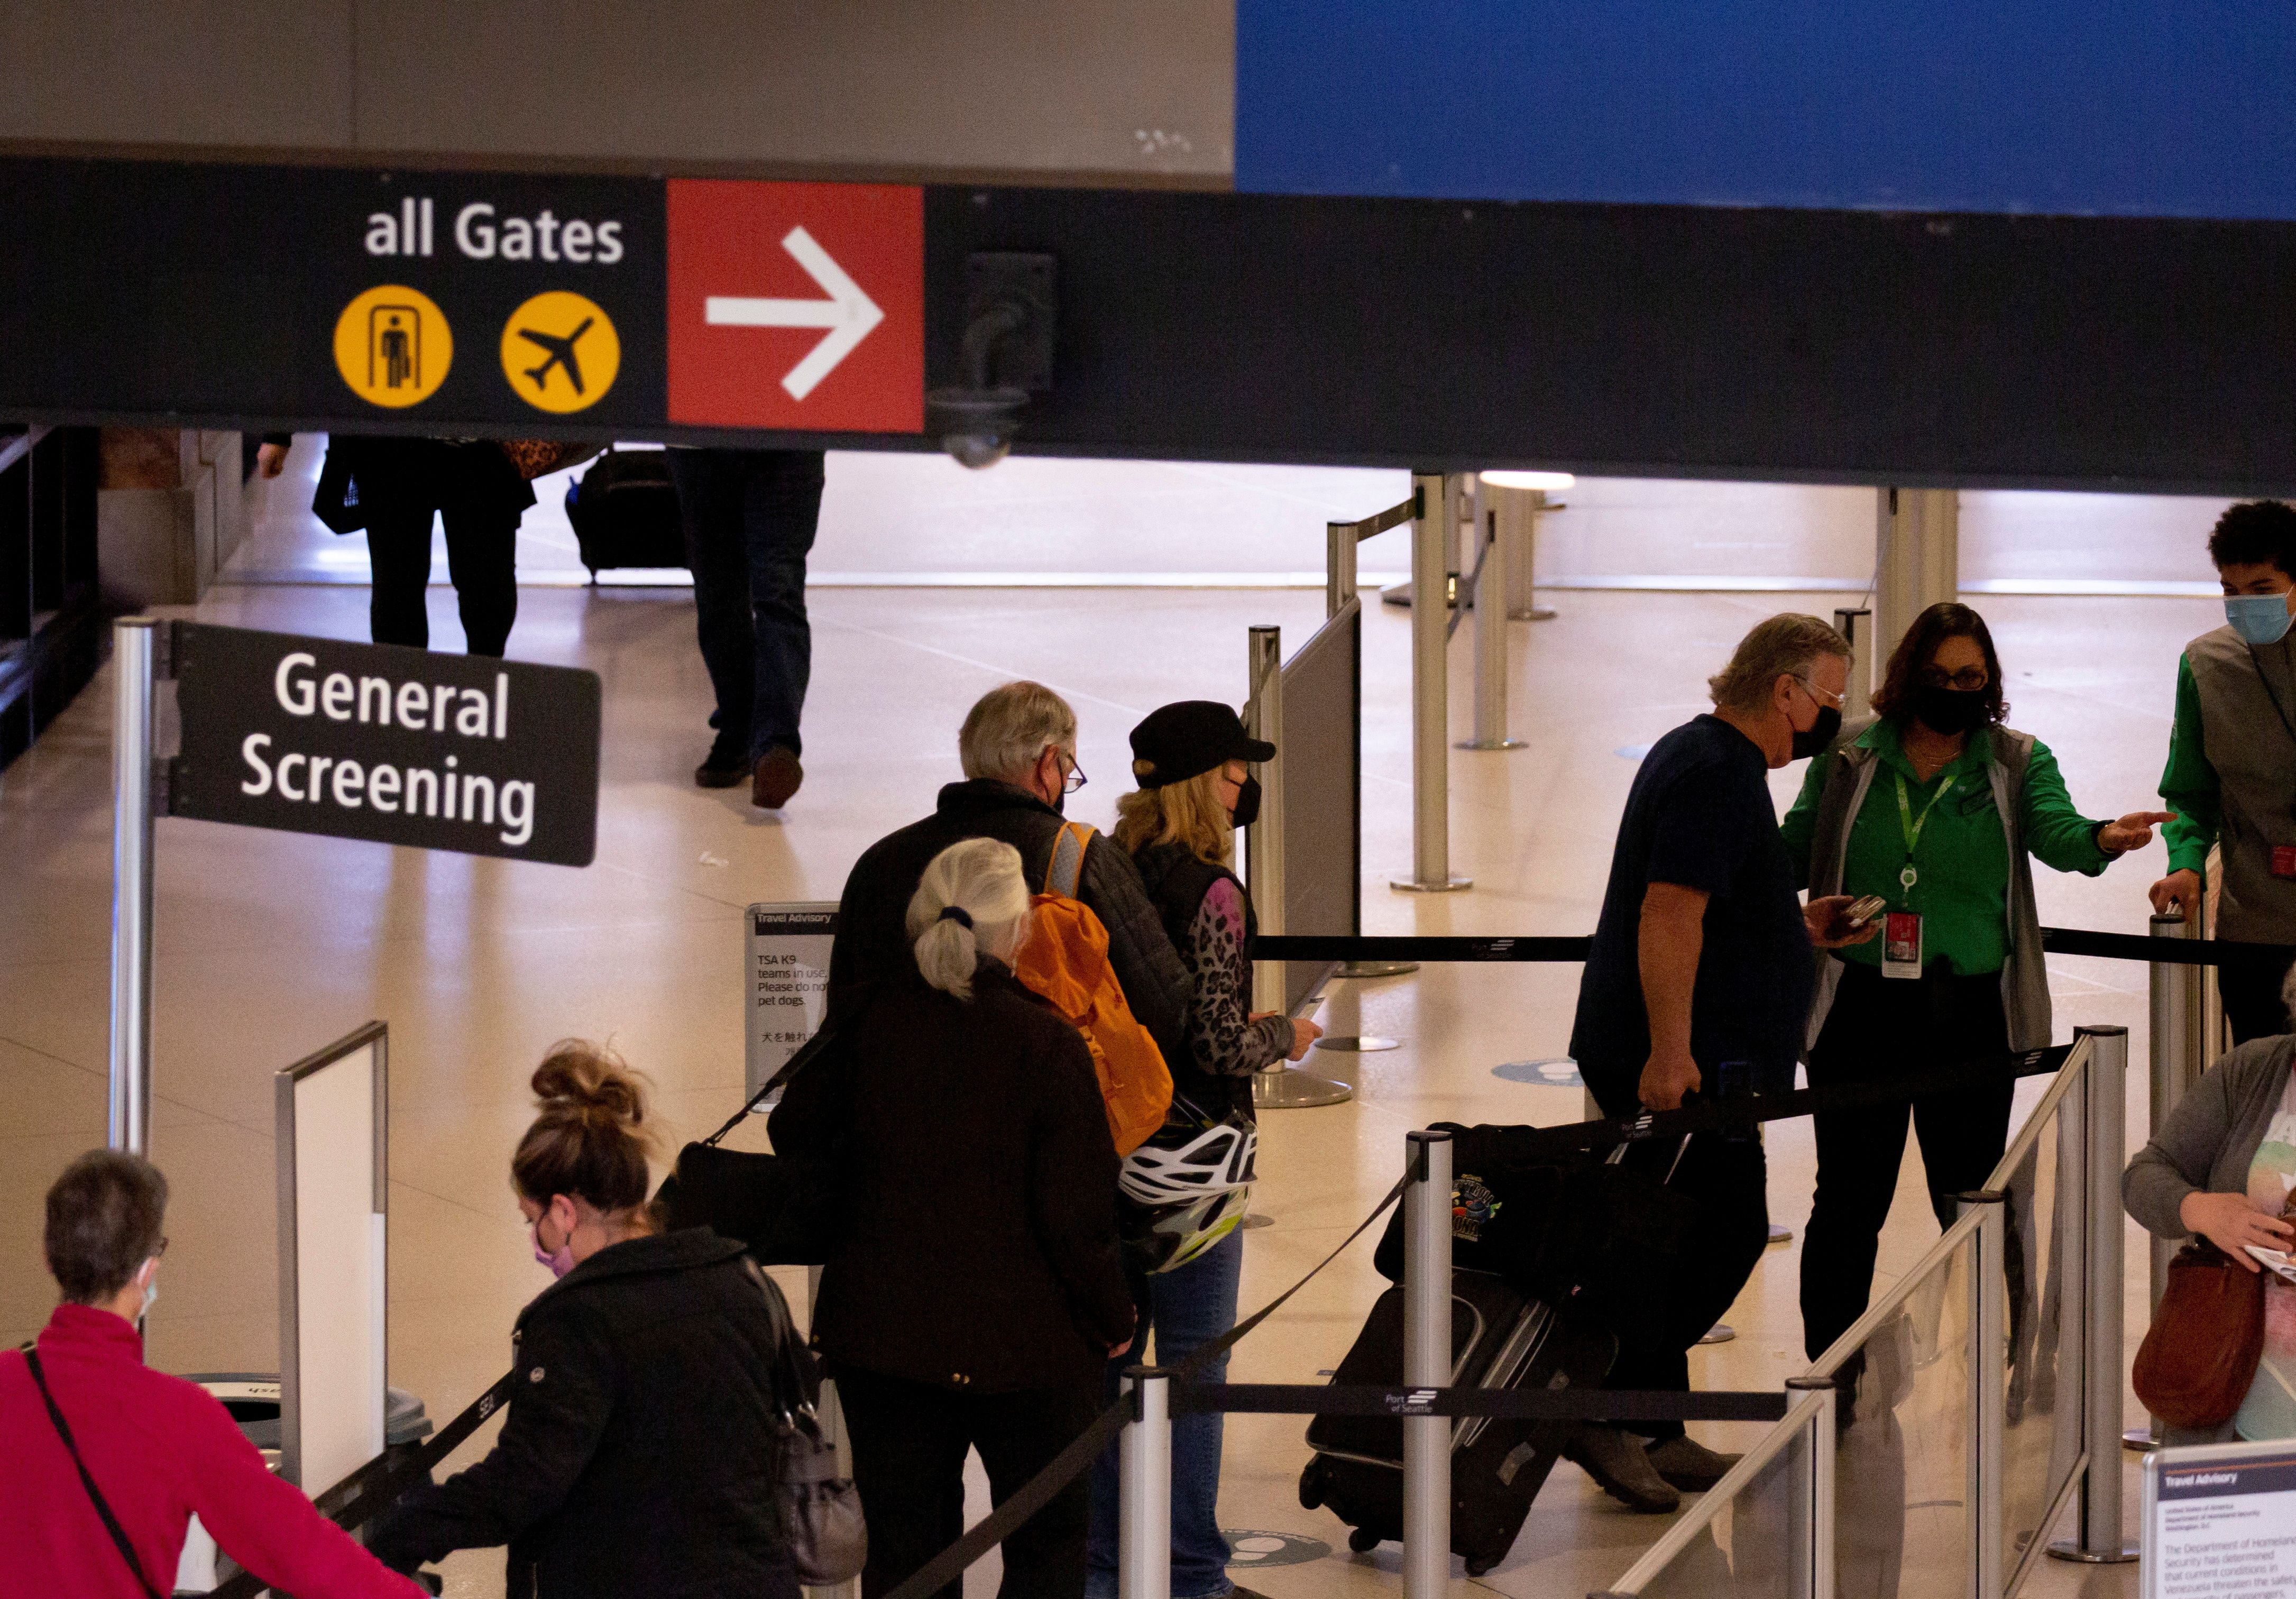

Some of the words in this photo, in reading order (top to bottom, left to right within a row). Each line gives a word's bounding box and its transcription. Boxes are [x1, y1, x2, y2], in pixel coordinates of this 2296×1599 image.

[364, 198, 433, 258] all
[455, 203, 624, 264] Gates
[275, 652, 509, 740] General
[241, 733, 536, 847] Screening
[758, 914, 786, 922] Travel
[788, 914, 831, 924] Advisory
[758, 955, 778, 964] TSA
[782, 955, 796, 964] K9
[758, 969, 791, 978] teams
[794, 968, 803, 978] in
[806, 969, 828, 978] use.
[758, 982, 793, 992] Please
[796, 982, 810, 992] do
[812, 982, 829, 992] no
[758, 996, 775, 1007] pet
[1385, 1394, 1405, 1403] Port
[1402, 1404, 1433, 1413] Seattle
[2165, 1474, 2194, 1487] Travel
[2195, 1472, 2238, 1485] Advisory
[2165, 1544, 2181, 1554] The
[2184, 1540, 2238, 1554] Department
[2240, 1538, 2250, 1548] of
[2165, 1557, 2201, 1569] Security
[2204, 1555, 2219, 1565] has
[2222, 1550, 2274, 1564] determined
[2164, 1571, 2182, 1581] that
[2185, 1568, 2218, 1580] current
[2220, 1565, 2266, 1577] conditions
[2270, 1564, 2278, 1573] in
[2254, 1577, 2268, 1586] the
